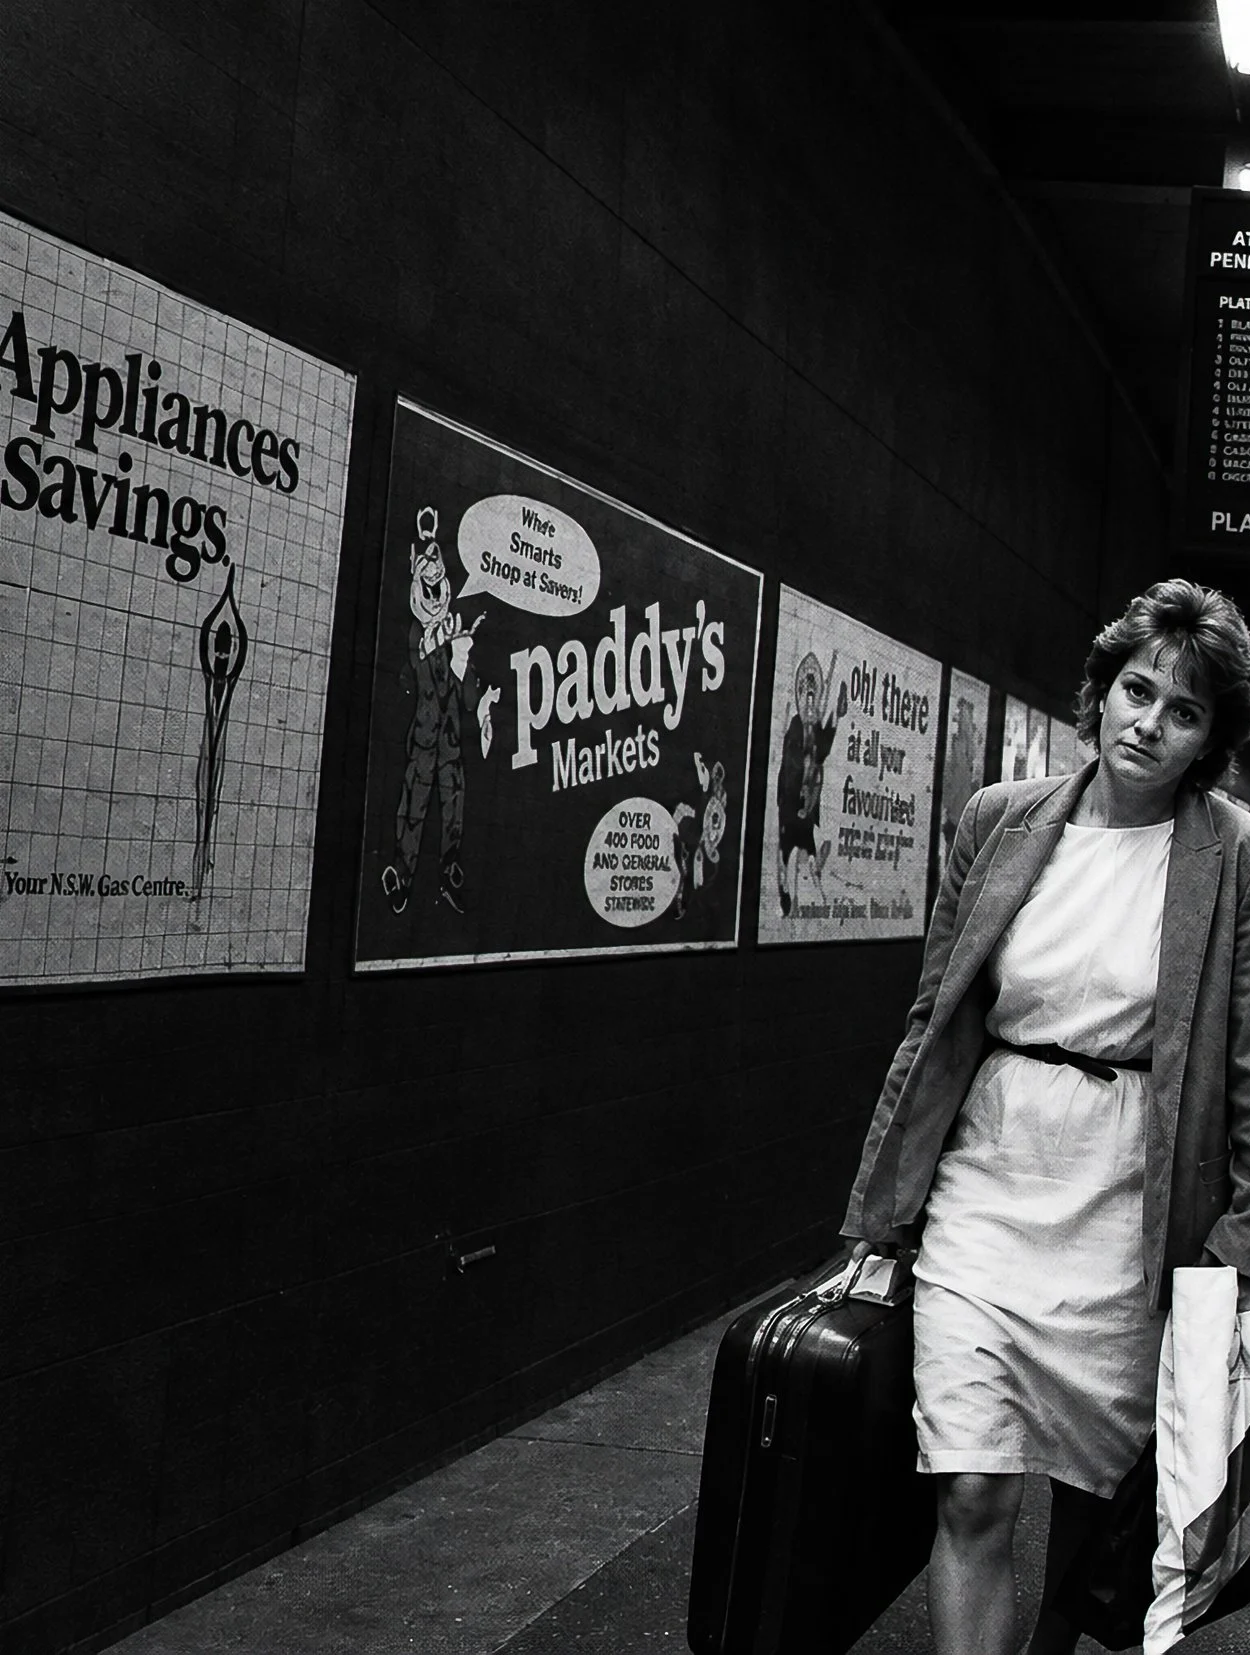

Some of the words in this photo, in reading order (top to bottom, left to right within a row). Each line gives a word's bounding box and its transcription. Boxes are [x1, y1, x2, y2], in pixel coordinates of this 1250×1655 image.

[0, 310, 300, 493] Appliances
[480, 550, 521, 586] Shop
[523, 570, 537, 589] at
[509, 531, 562, 570] Smarts
[511, 600, 726, 770] paddy's
[881, 671, 930, 736] there
[551, 728, 661, 793] Markets
[619, 811, 651, 830] OVER
[604, 831, 628, 849] 400
[630, 833, 660, 850] FOOD
[592, 852, 619, 871] AND
[4, 871, 49, 896] Your
[97, 874, 131, 897] Gas
